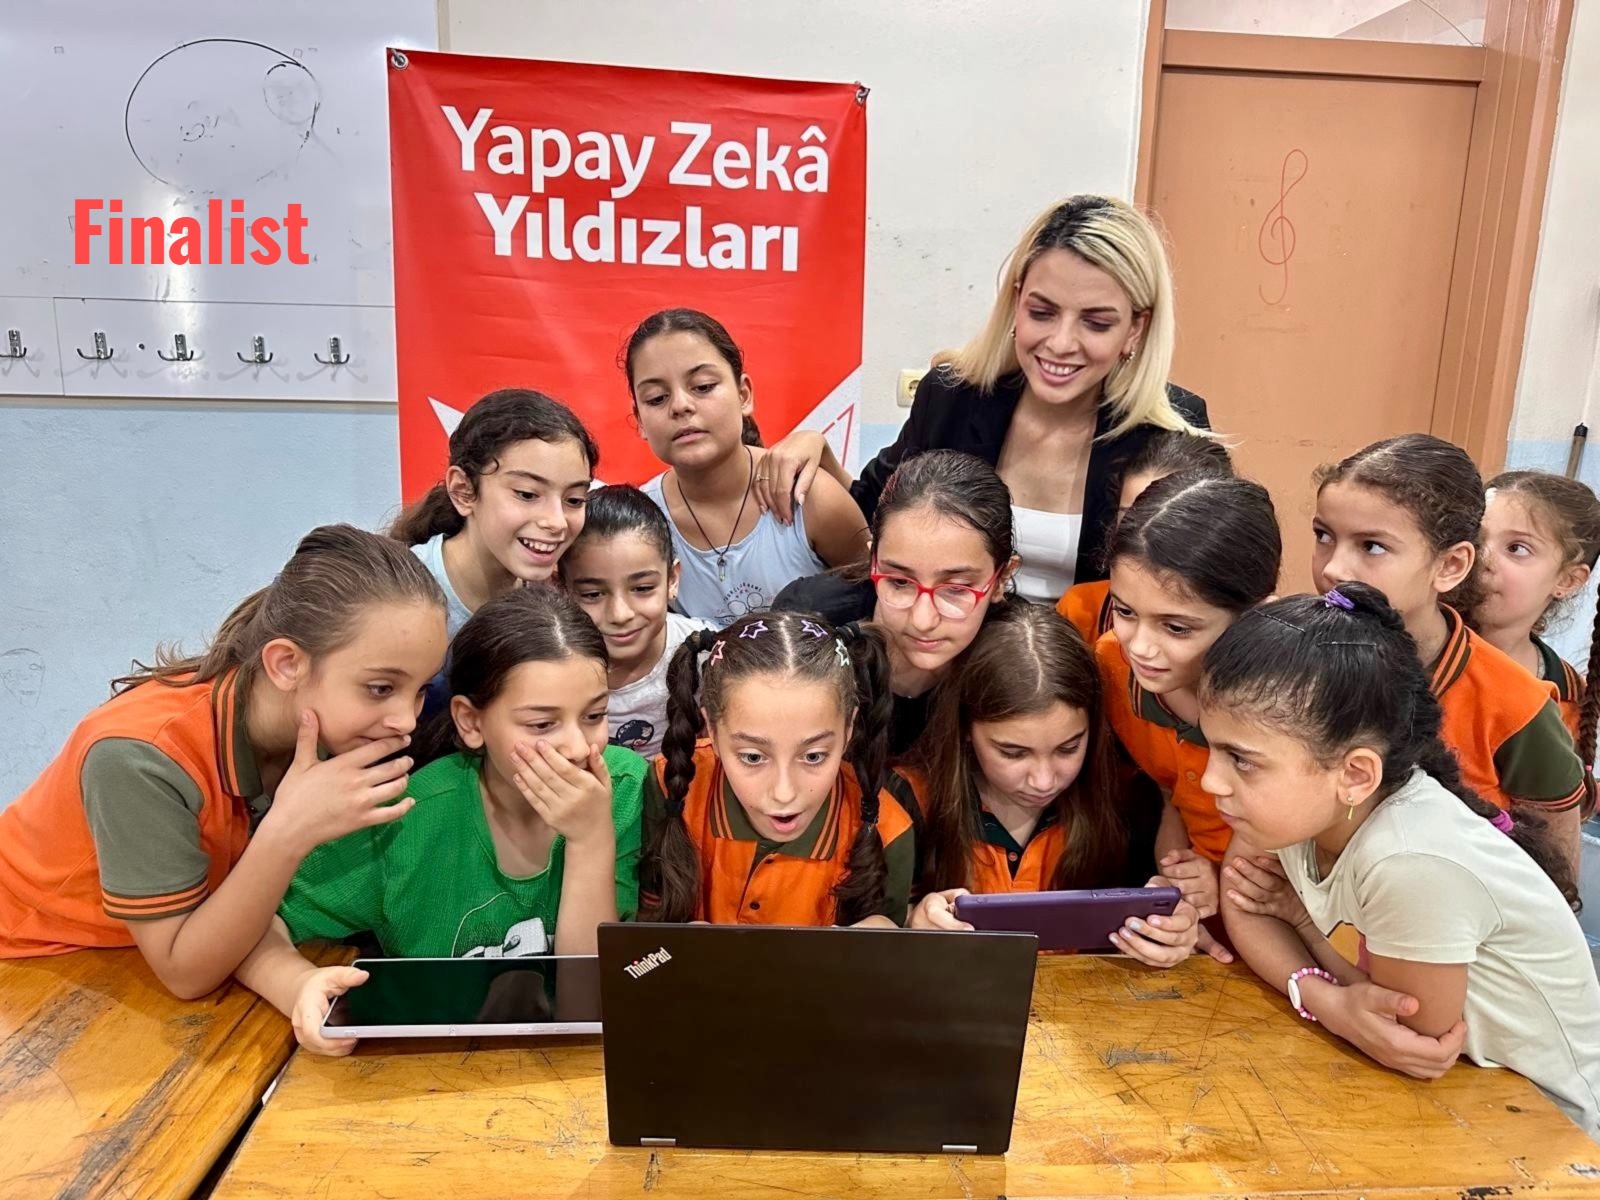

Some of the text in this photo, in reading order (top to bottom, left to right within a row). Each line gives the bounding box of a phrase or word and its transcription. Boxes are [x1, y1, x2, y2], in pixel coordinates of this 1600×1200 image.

[440, 105, 829, 199] Yapay Zekâ
[474, 192, 799, 272] Yıldızları
[623, 946, 673, 979] ThinkPad
